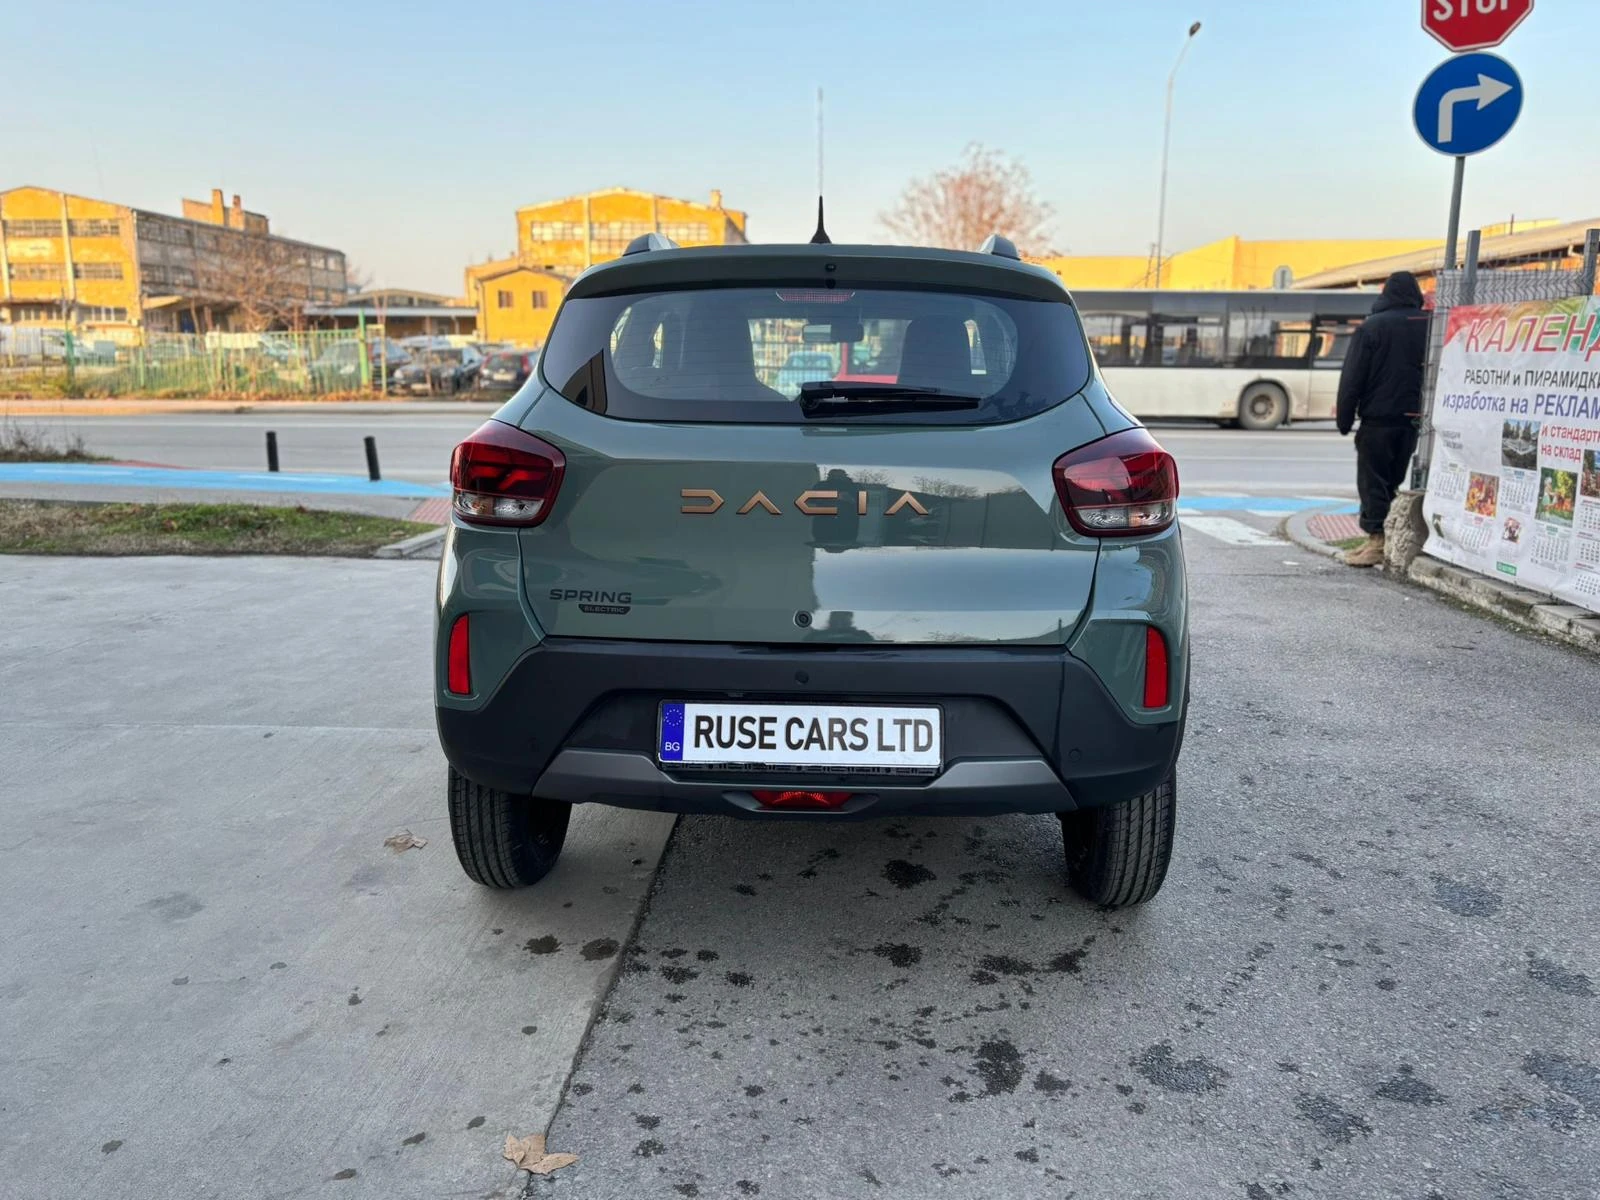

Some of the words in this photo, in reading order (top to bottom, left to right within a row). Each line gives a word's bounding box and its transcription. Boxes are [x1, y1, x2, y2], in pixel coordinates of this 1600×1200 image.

[1464, 369, 1510, 385] РАБОТНИ
[1513, 374, 1520, 386] и
[1443, 390, 1506, 414] изработка
[1510, 397, 1529, 415] на
[1541, 444, 1552, 456] на
[1554, 445, 1581, 463] склад
[681, 488, 929, 515] DACIA
[549, 588, 632, 604] SPRING
[583, 605, 625, 614] ELECTRIC
[694, 715, 777, 750] RUSE
[785, 716, 869, 751] CARS
[877, 718, 933, 753] LTD
[664, 741, 681, 751] BG
